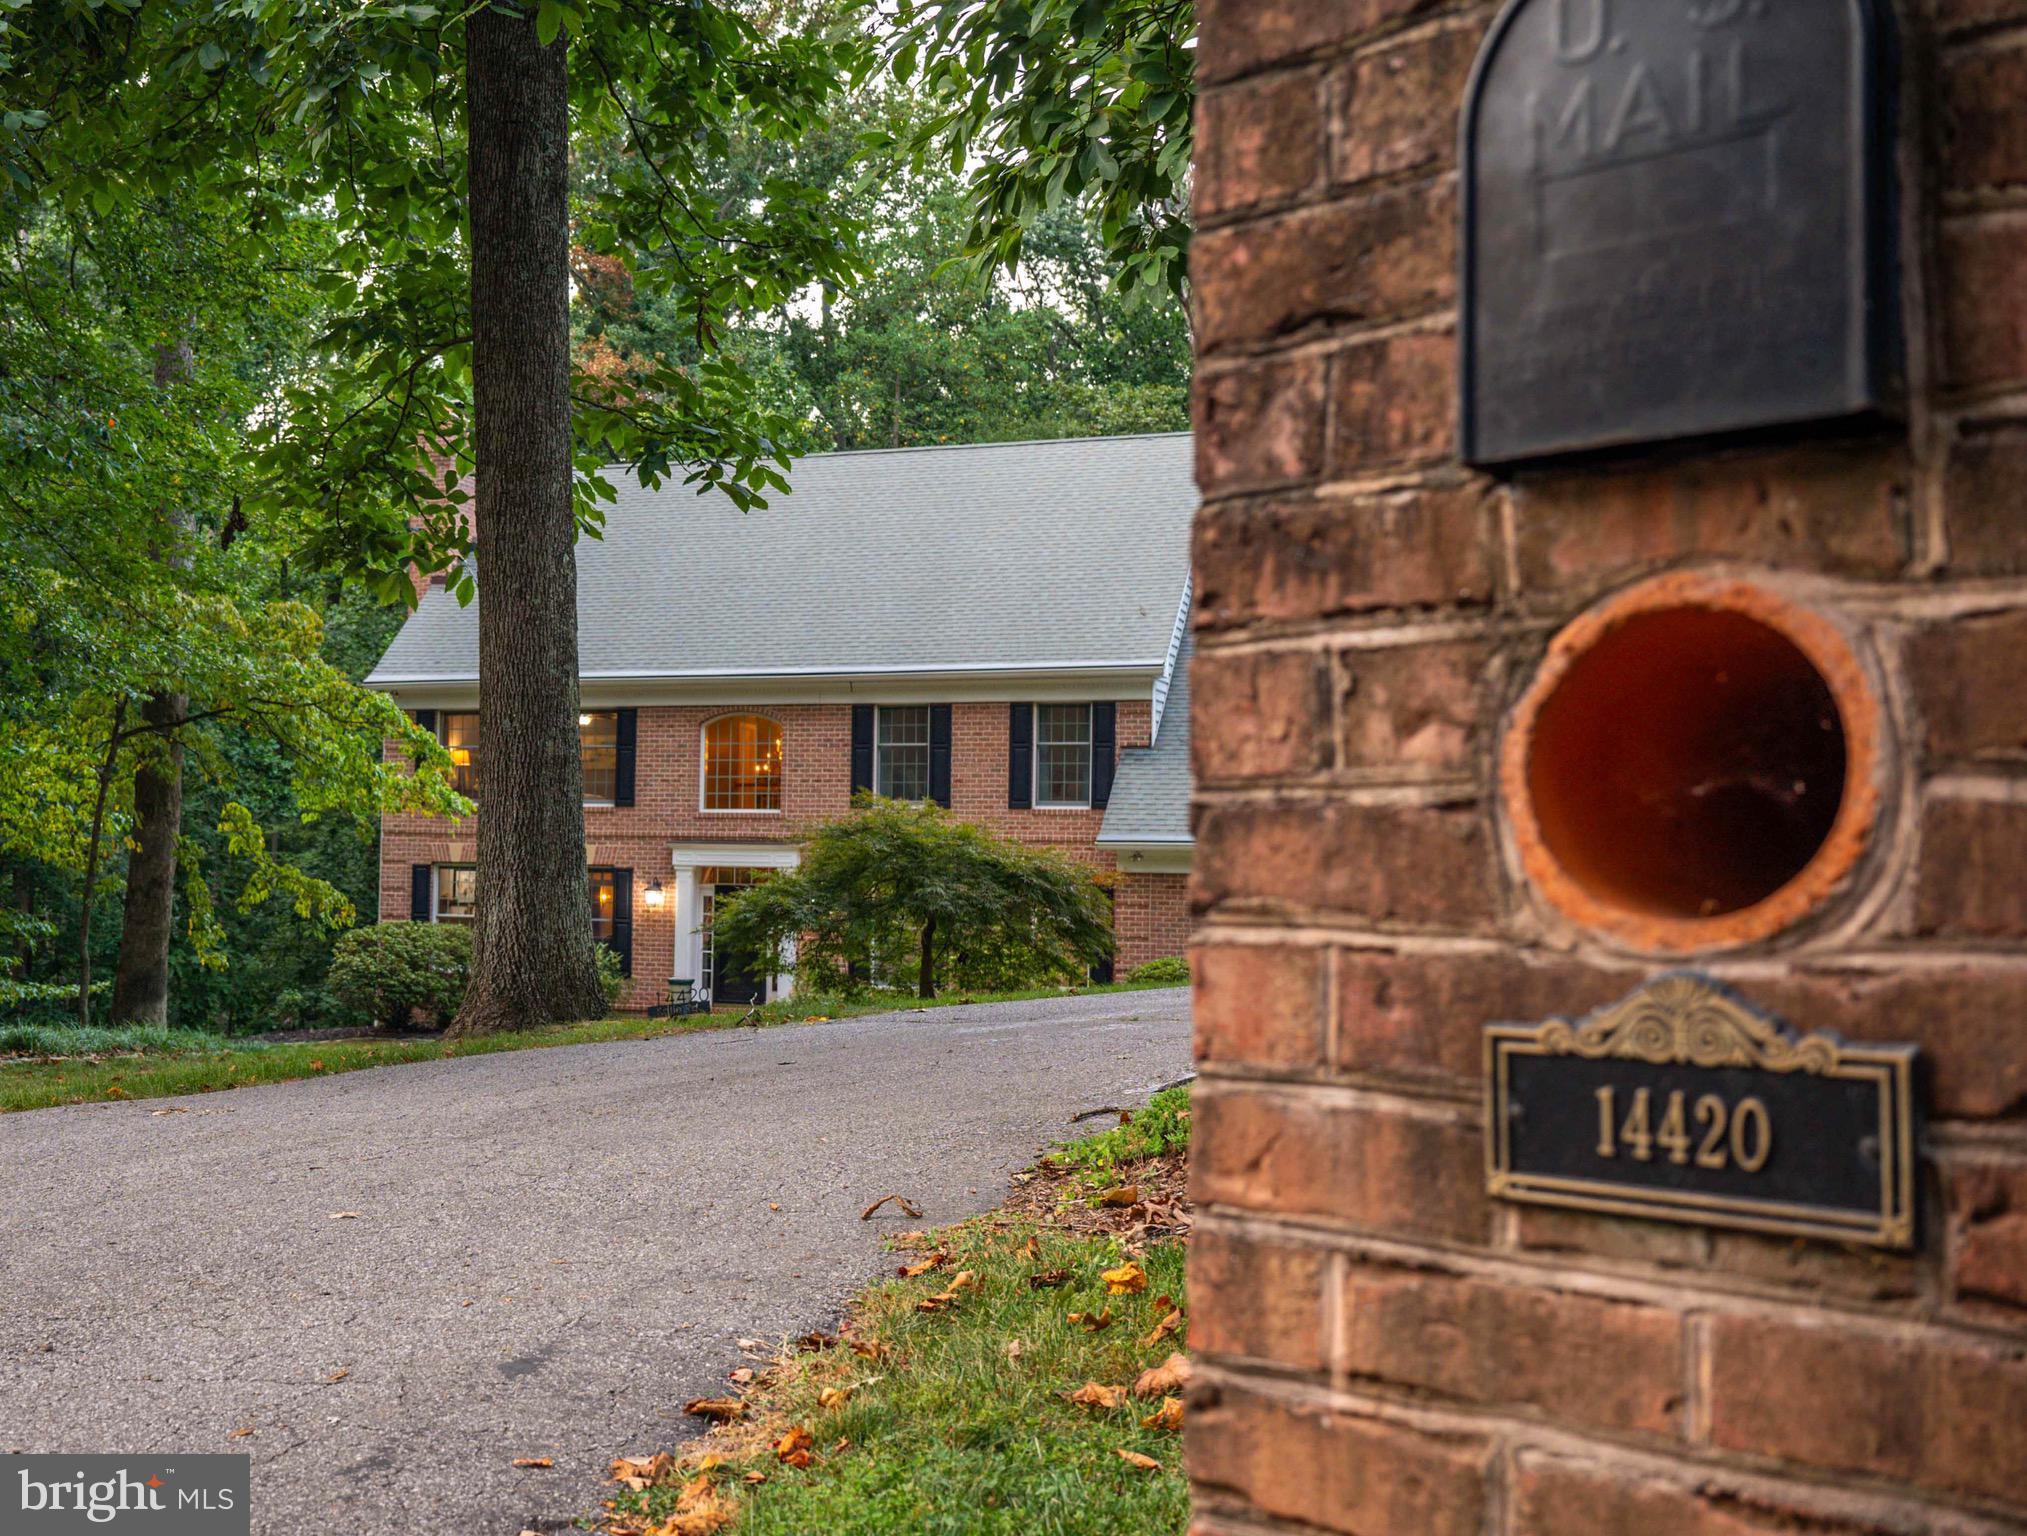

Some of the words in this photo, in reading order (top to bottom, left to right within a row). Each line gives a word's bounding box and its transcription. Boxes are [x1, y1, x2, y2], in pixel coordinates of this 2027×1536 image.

[1524, 36, 1795, 158] MAIL
[656, 986, 710, 1006] 14420
[1594, 1084, 1772, 1173] 14420
